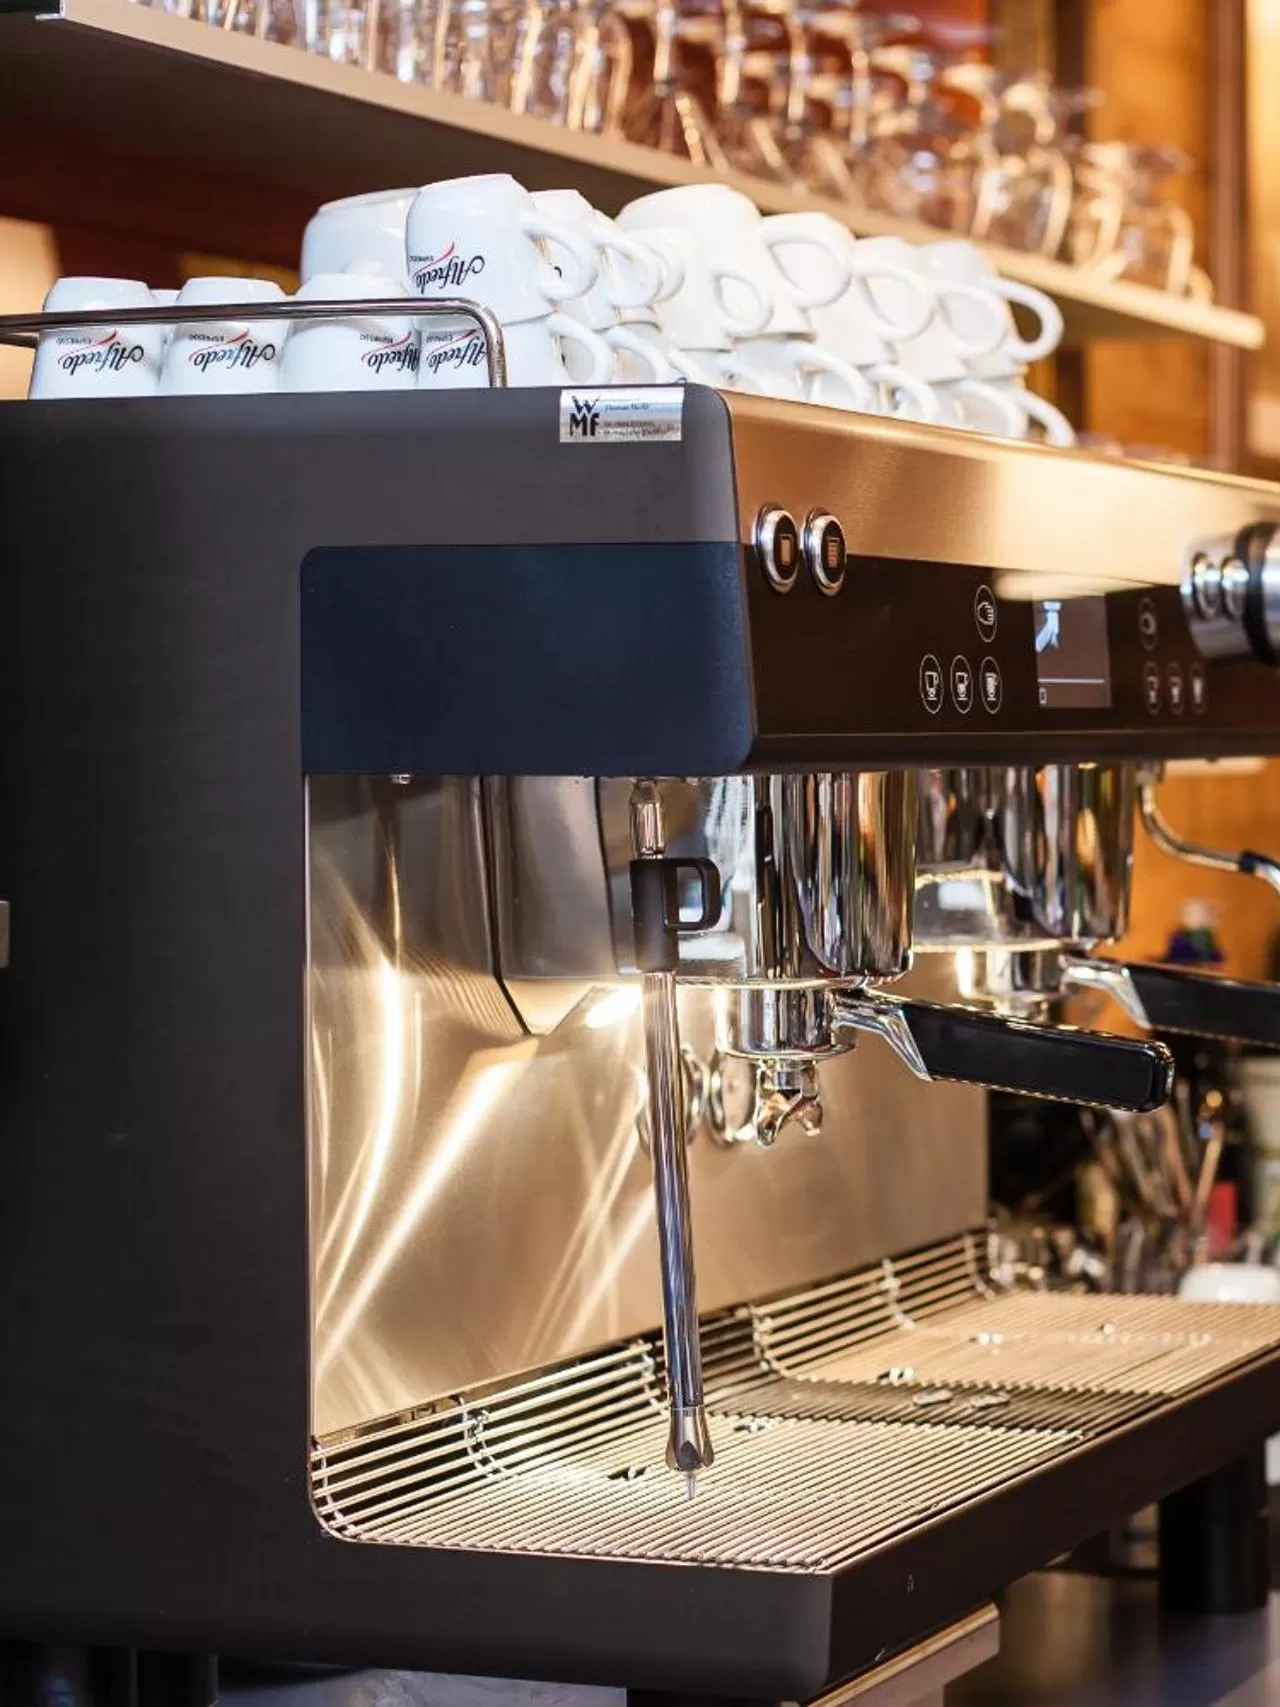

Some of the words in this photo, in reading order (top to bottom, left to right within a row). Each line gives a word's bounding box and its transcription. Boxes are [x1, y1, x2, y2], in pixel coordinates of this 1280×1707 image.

[415, 254, 485, 294] Alfredo
[62, 340, 144, 376] Alfredo
[193, 339, 276, 372] Alfredo
